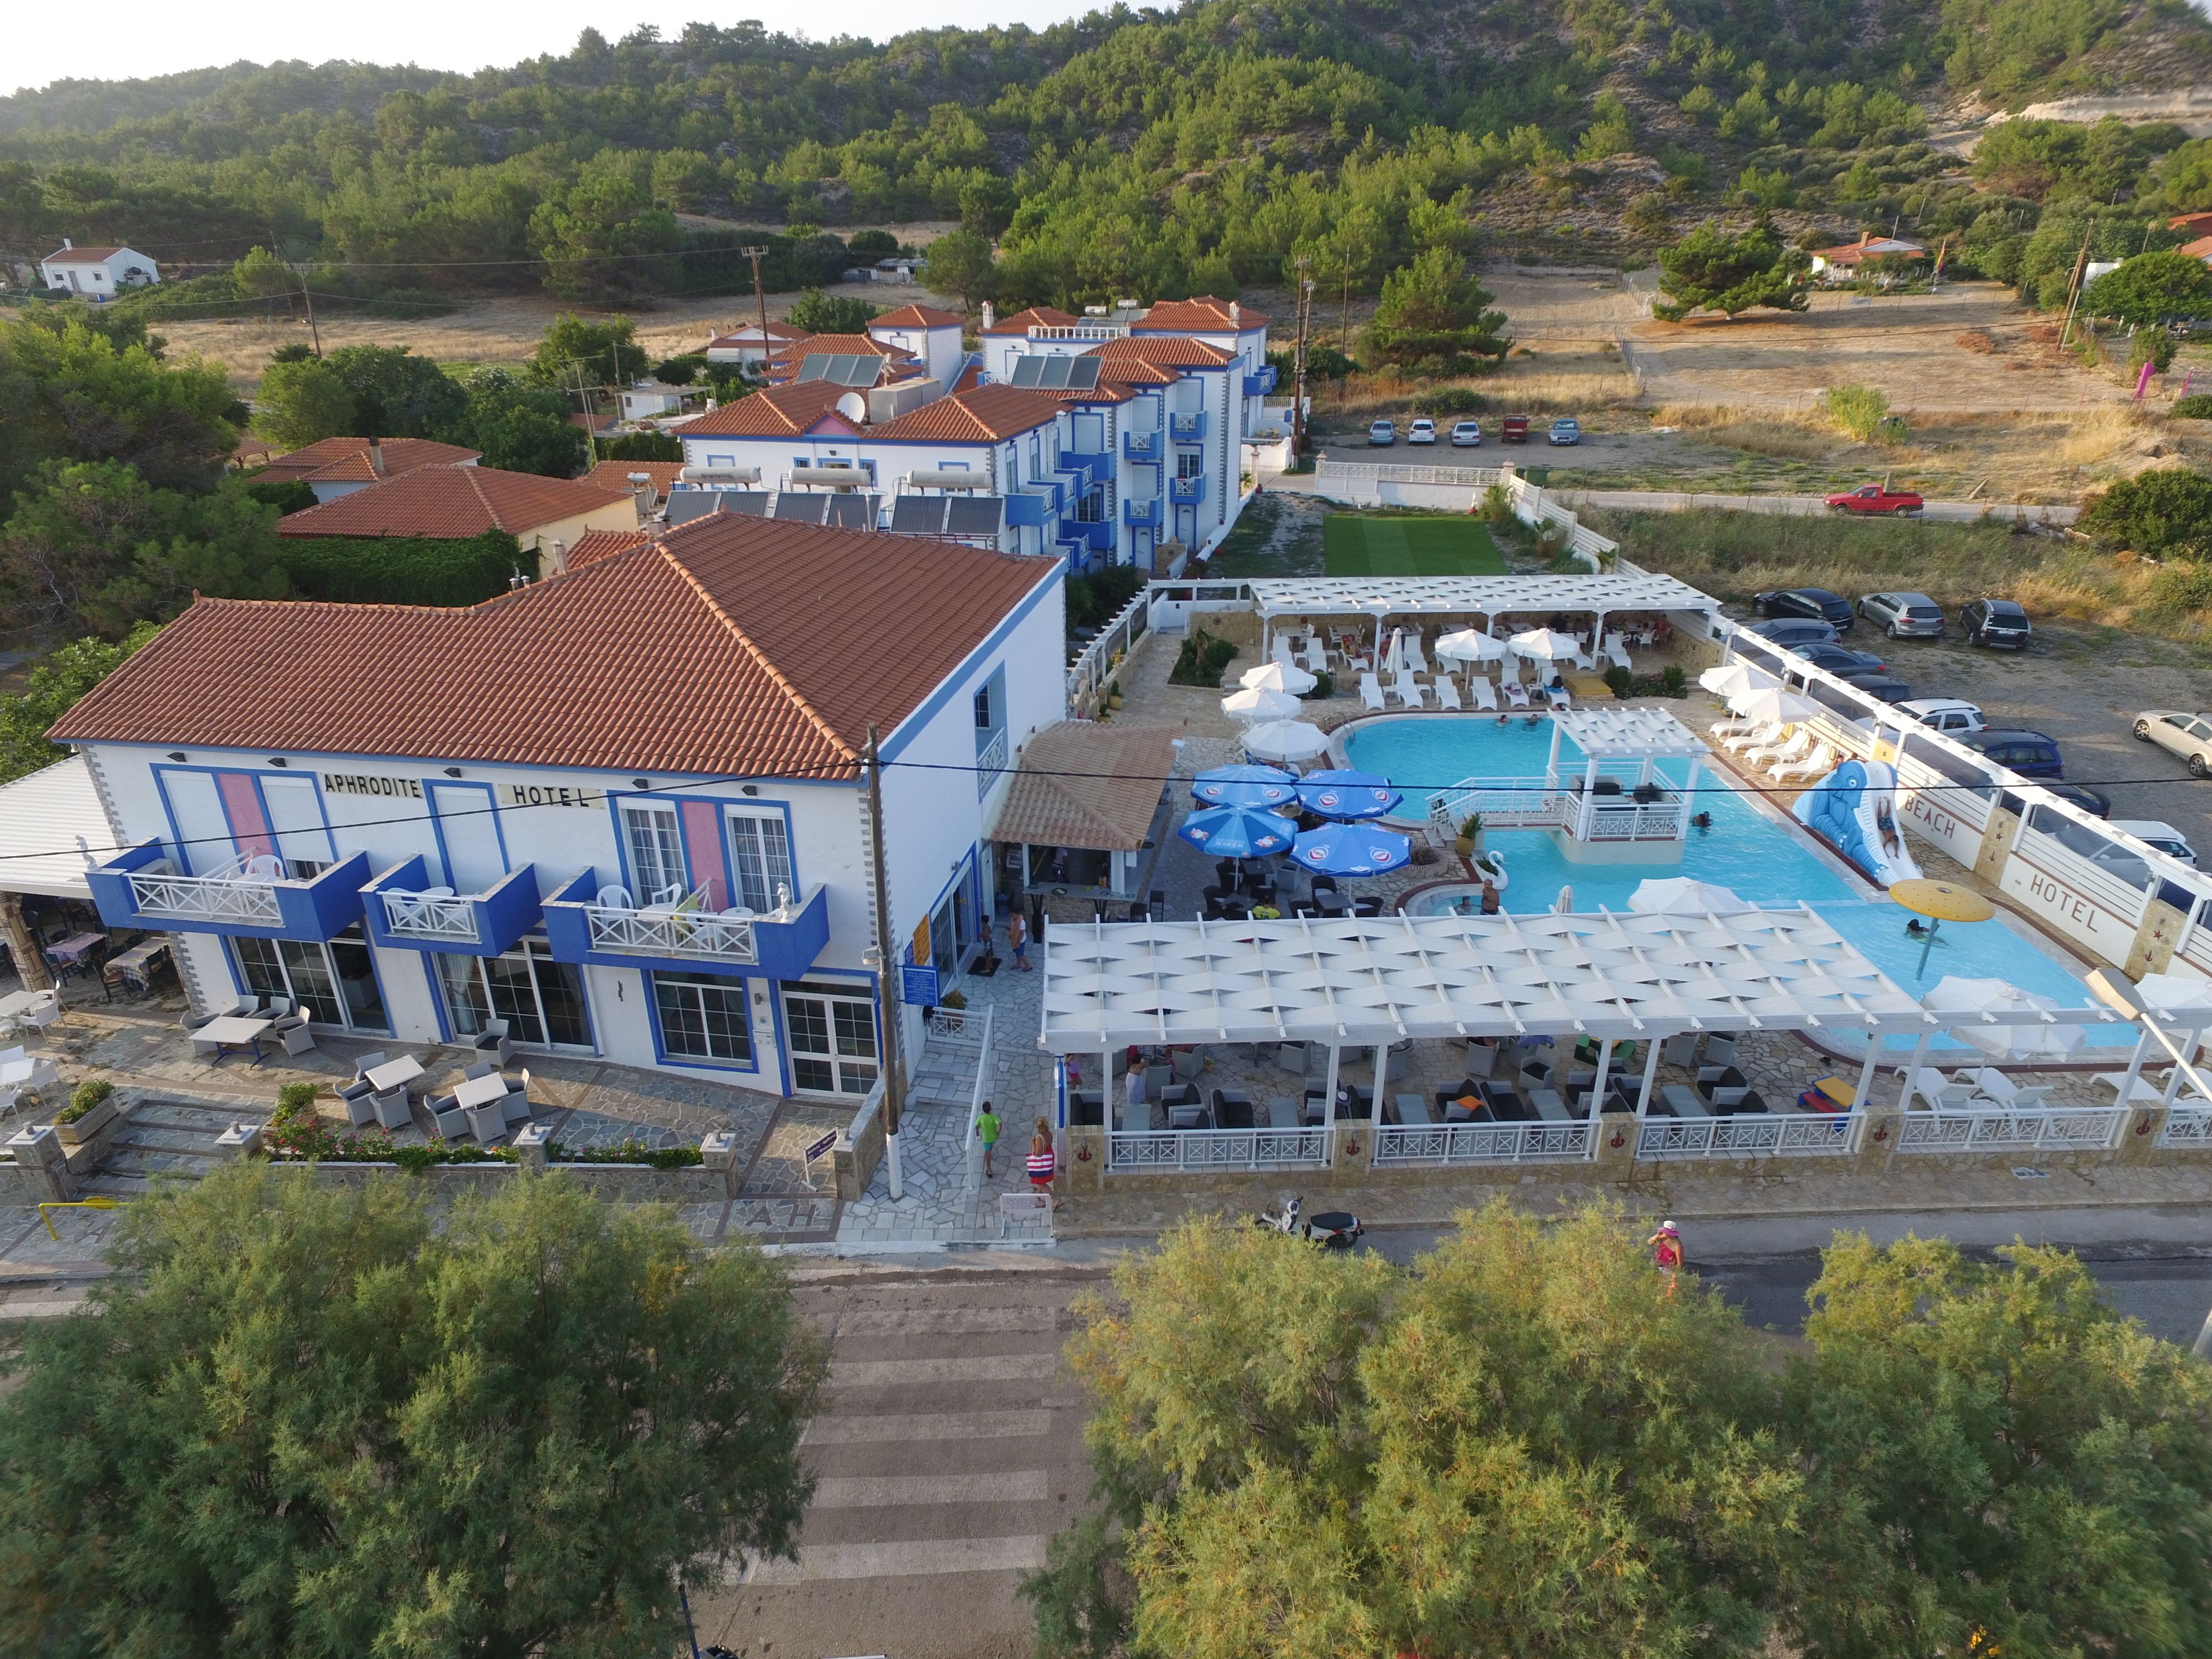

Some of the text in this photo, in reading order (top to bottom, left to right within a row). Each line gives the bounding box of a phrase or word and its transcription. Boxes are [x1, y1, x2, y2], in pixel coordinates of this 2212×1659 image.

[324, 774, 589, 808] APHRODITE HOTEL
[1904, 794, 1956, 839] BEACH
[2030, 874, 2098, 933] HOTEL
